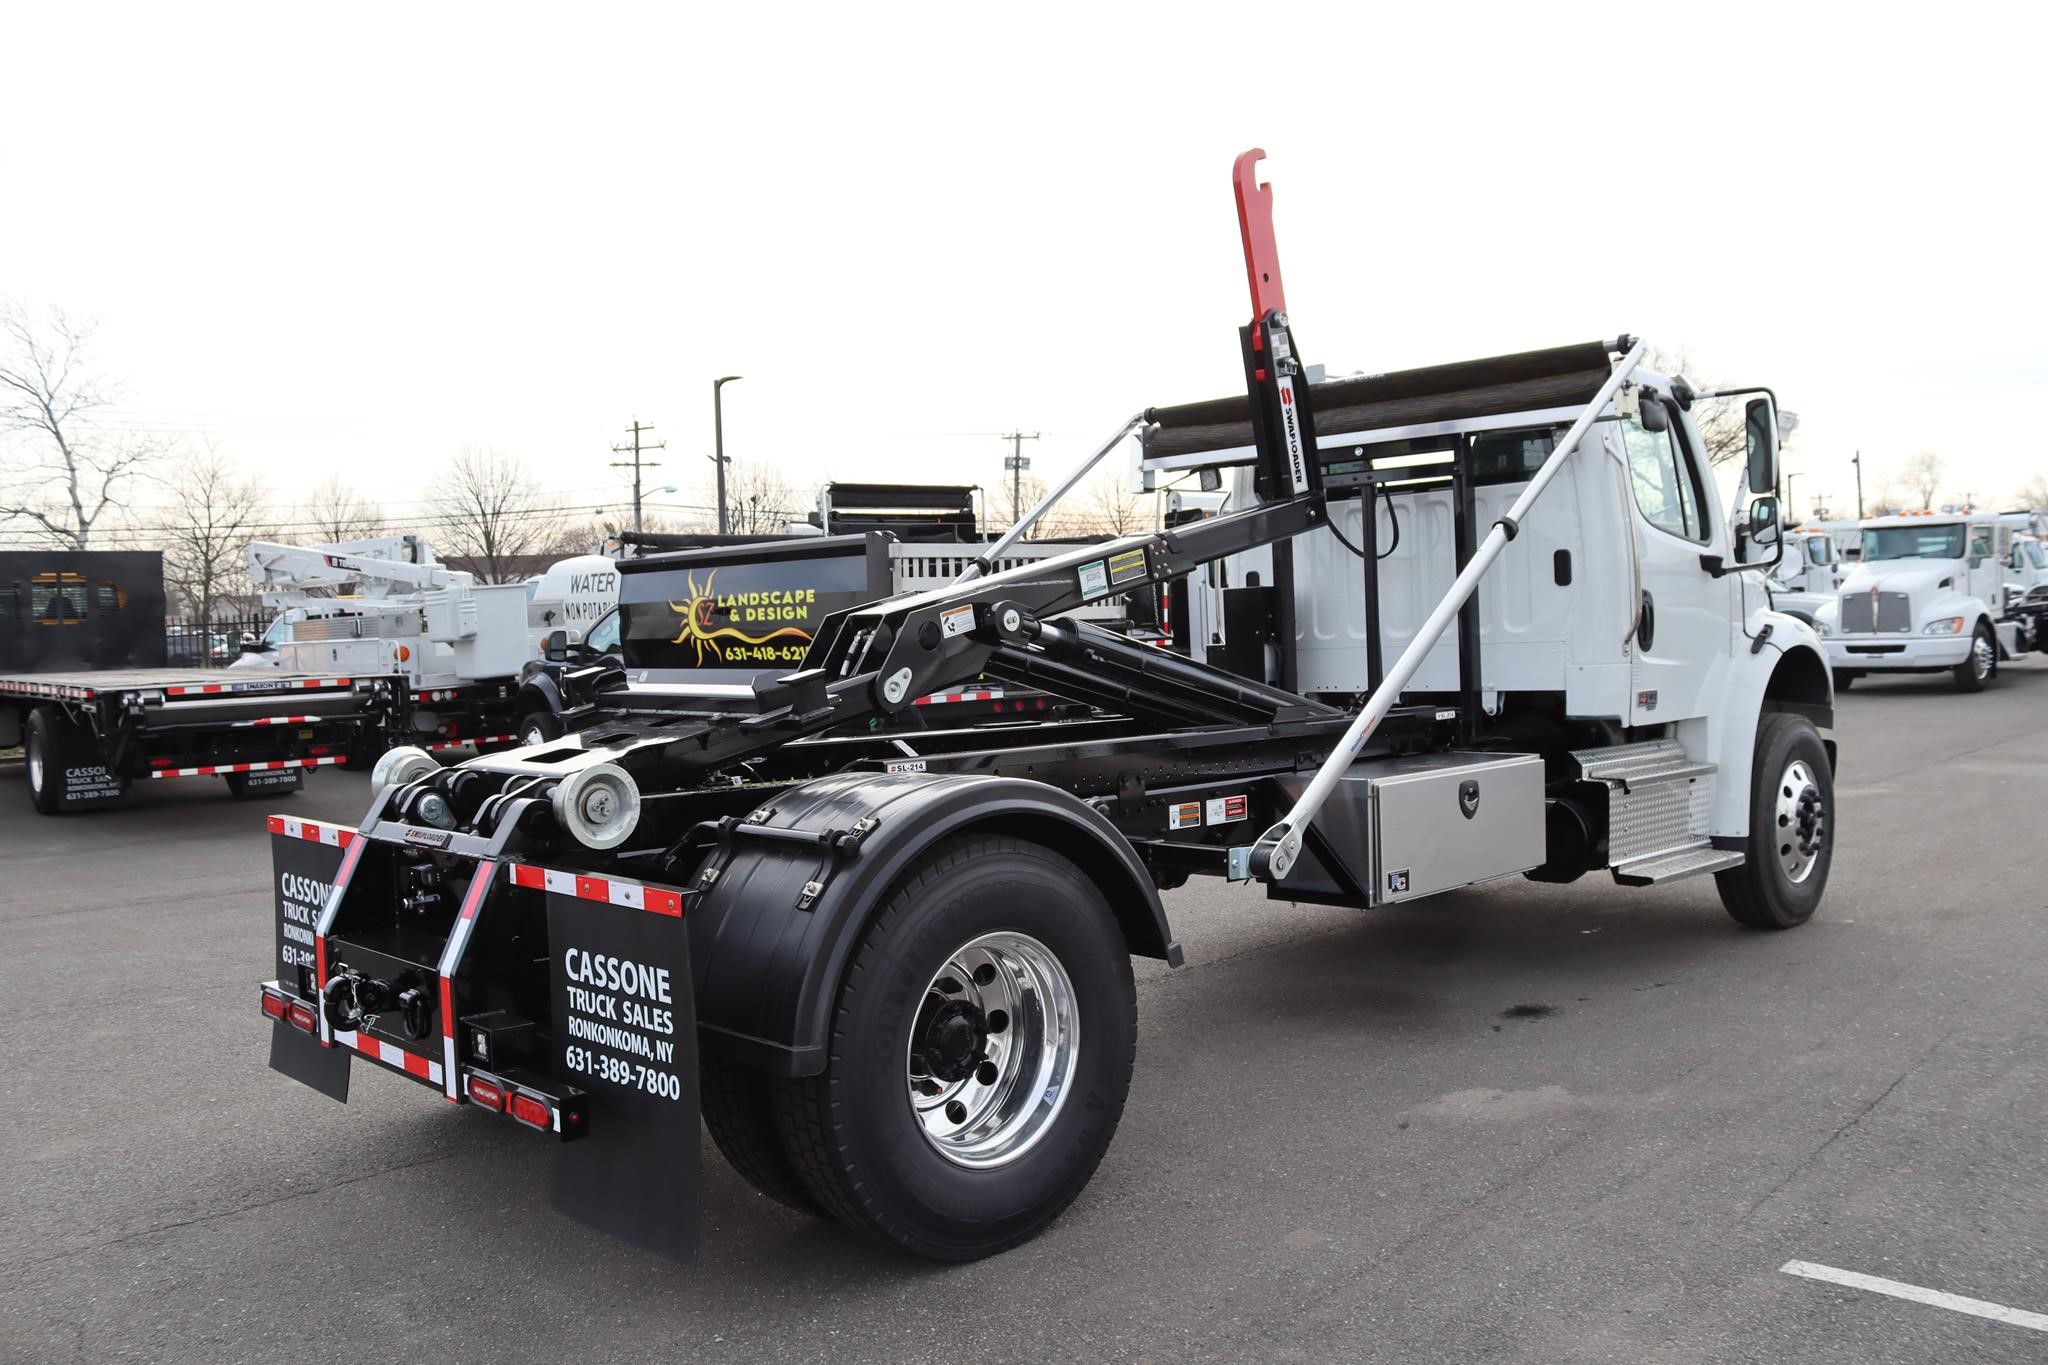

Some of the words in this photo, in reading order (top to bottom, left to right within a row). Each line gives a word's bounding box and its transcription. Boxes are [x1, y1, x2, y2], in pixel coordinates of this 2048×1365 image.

[1285, 408, 1303, 484] SWAPLOADER
[570, 572, 615, 594] WATER
[717, 589, 816, 607] LANDSCAPE
[564, 602, 581, 620] NON
[729, 609, 740, 622] &
[746, 605, 808, 622] DESIGN
[725, 645, 809, 661] 631-418-621
[65, 766, 106, 778] CASSO
[896, 763, 924, 772] SL-214
[248, 775, 297, 786] 631-389-7800
[65, 788, 120, 801] 631-389-7800
[281, 872, 332, 907] CASSON
[282, 900, 310, 926] TRUCK
[565, 947, 673, 1005] CASSONE
[566, 985, 618, 1021] TRUCK
[622, 1000, 674, 1035] SALES
[568, 1015, 654, 1062] RONKONKOMA,
[655, 1039, 674, 1064] NY
[566, 1045, 681, 1101] 631-389-7800
